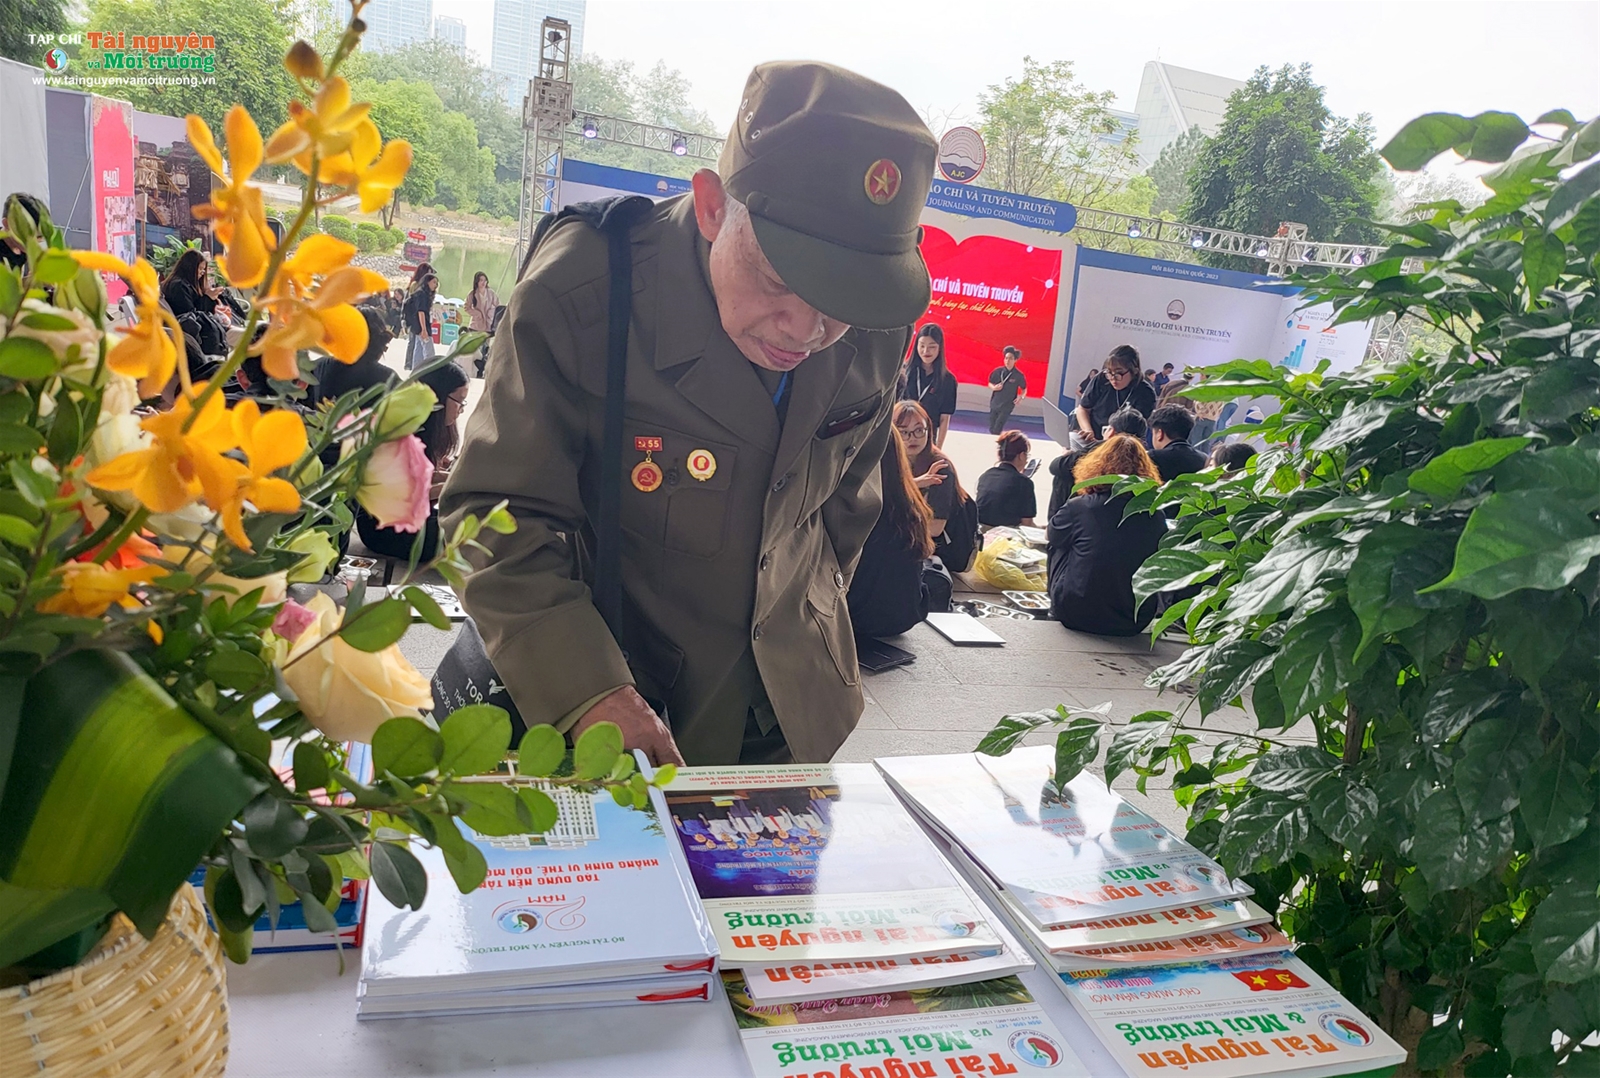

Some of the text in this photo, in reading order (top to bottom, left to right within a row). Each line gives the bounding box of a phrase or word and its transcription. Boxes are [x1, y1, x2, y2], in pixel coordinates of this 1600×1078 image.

[951, 170, 966, 178] AJC
[944, 186, 964, 198] CHÍ
[966, 189, 979, 201] VÀ
[982, 193, 1016, 208] TUYÊN
[1018, 200, 1058, 216] TRUYỀN
[928, 197, 1055, 227] JOURNALISM AND COMMUNICATION
[933, 276, 1024, 304] CHÍ VÀ TUYÊN TRUYỀN
[1113, 316, 1232, 338] HỌC VIỆN BÁO CHÍ VÀ TUYÊN TRUYỀN
[568, 862, 580, 872] VỊ
[584, 860, 614, 870] ĐỊNH
[537, 875, 571, 886] DỰNG
[576, 873, 600, 884] TẠO
[1104, 865, 1158, 884] Môi
[1144, 878, 1198, 897] Tài
[527, 894, 566, 904] NĂM
[724, 910, 832, 930] trường
[835, 908, 900, 926] Môi
[548, 939, 590, 949] NGUYÊN
[592, 938, 609, 946] TÀI
[730, 926, 938, 951] Tài nguyên
[508, 944, 530, 952] MÔI
[532, 943, 546, 951] VÀ
[1088, 994, 1113, 1005] MỚI
[1113, 992, 1140, 1002] NĂM
[1139, 988, 1174, 1000] MỪNG
[1174, 987, 1200, 999] CHÚC
[1282, 1011, 1306, 1025] &
[1220, 1013, 1291, 1038] Môi
[968, 1028, 993, 1040] và
[1114, 1020, 1224, 1046] trường
[898, 1030, 972, 1056] Môi
[772, 1038, 895, 1068] trường
[1136, 1033, 1339, 1070] Tài nguyên
[944, 1052, 1018, 1078] Tài
